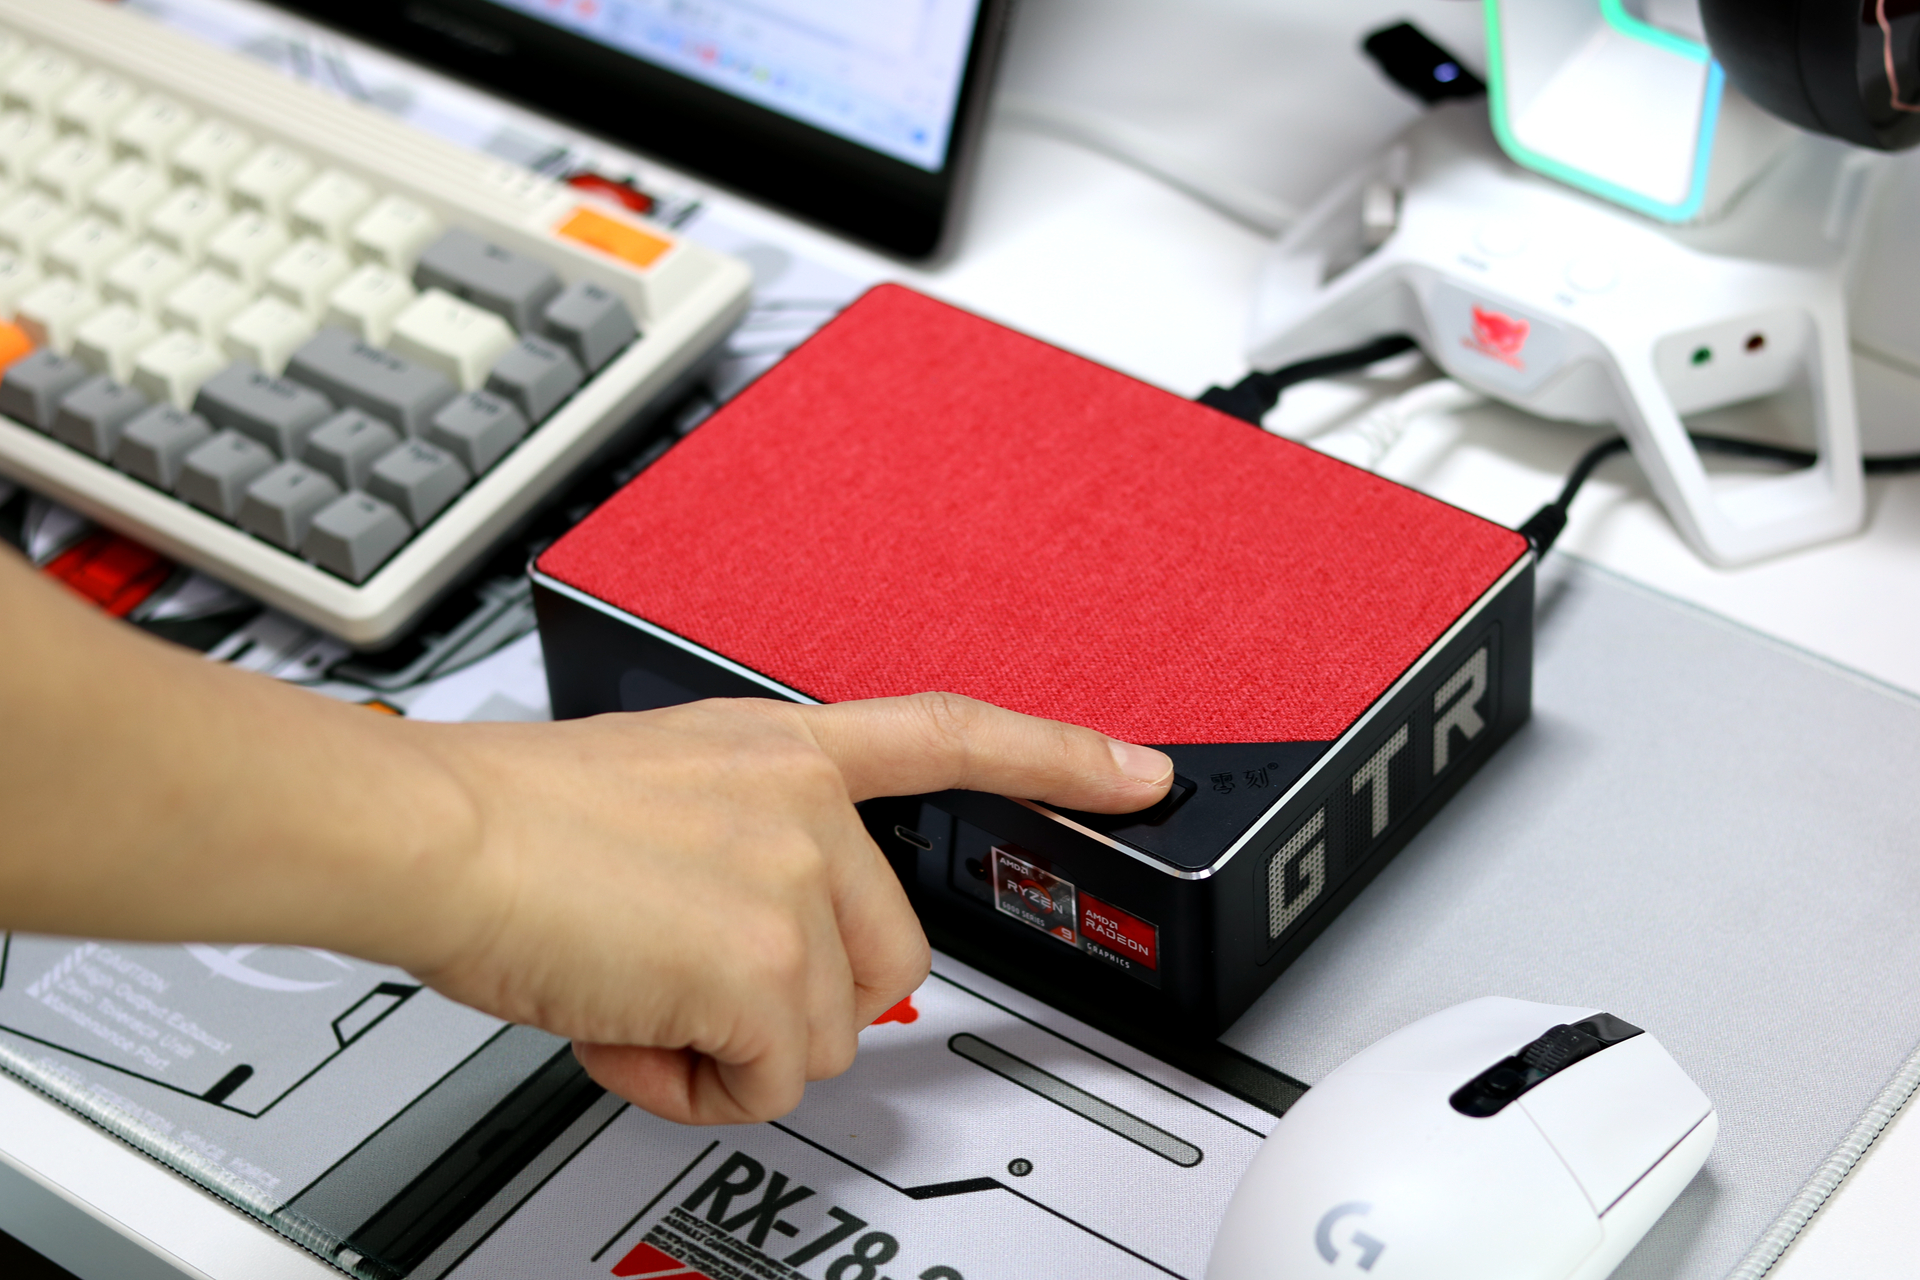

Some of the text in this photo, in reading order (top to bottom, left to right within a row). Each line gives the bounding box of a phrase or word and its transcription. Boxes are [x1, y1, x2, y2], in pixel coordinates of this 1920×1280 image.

[1268, 647, 1488, 939] GTR
[1007, 879, 1063, 914] RYZEN
[1021, 910, 1045, 927] SERIES
[1061, 927, 1072, 940] 9
[1085, 917, 1149, 956] RADEON
[1086, 942, 1130, 969] GRAPHICS
[682, 1151, 965, 1280] RX-78
